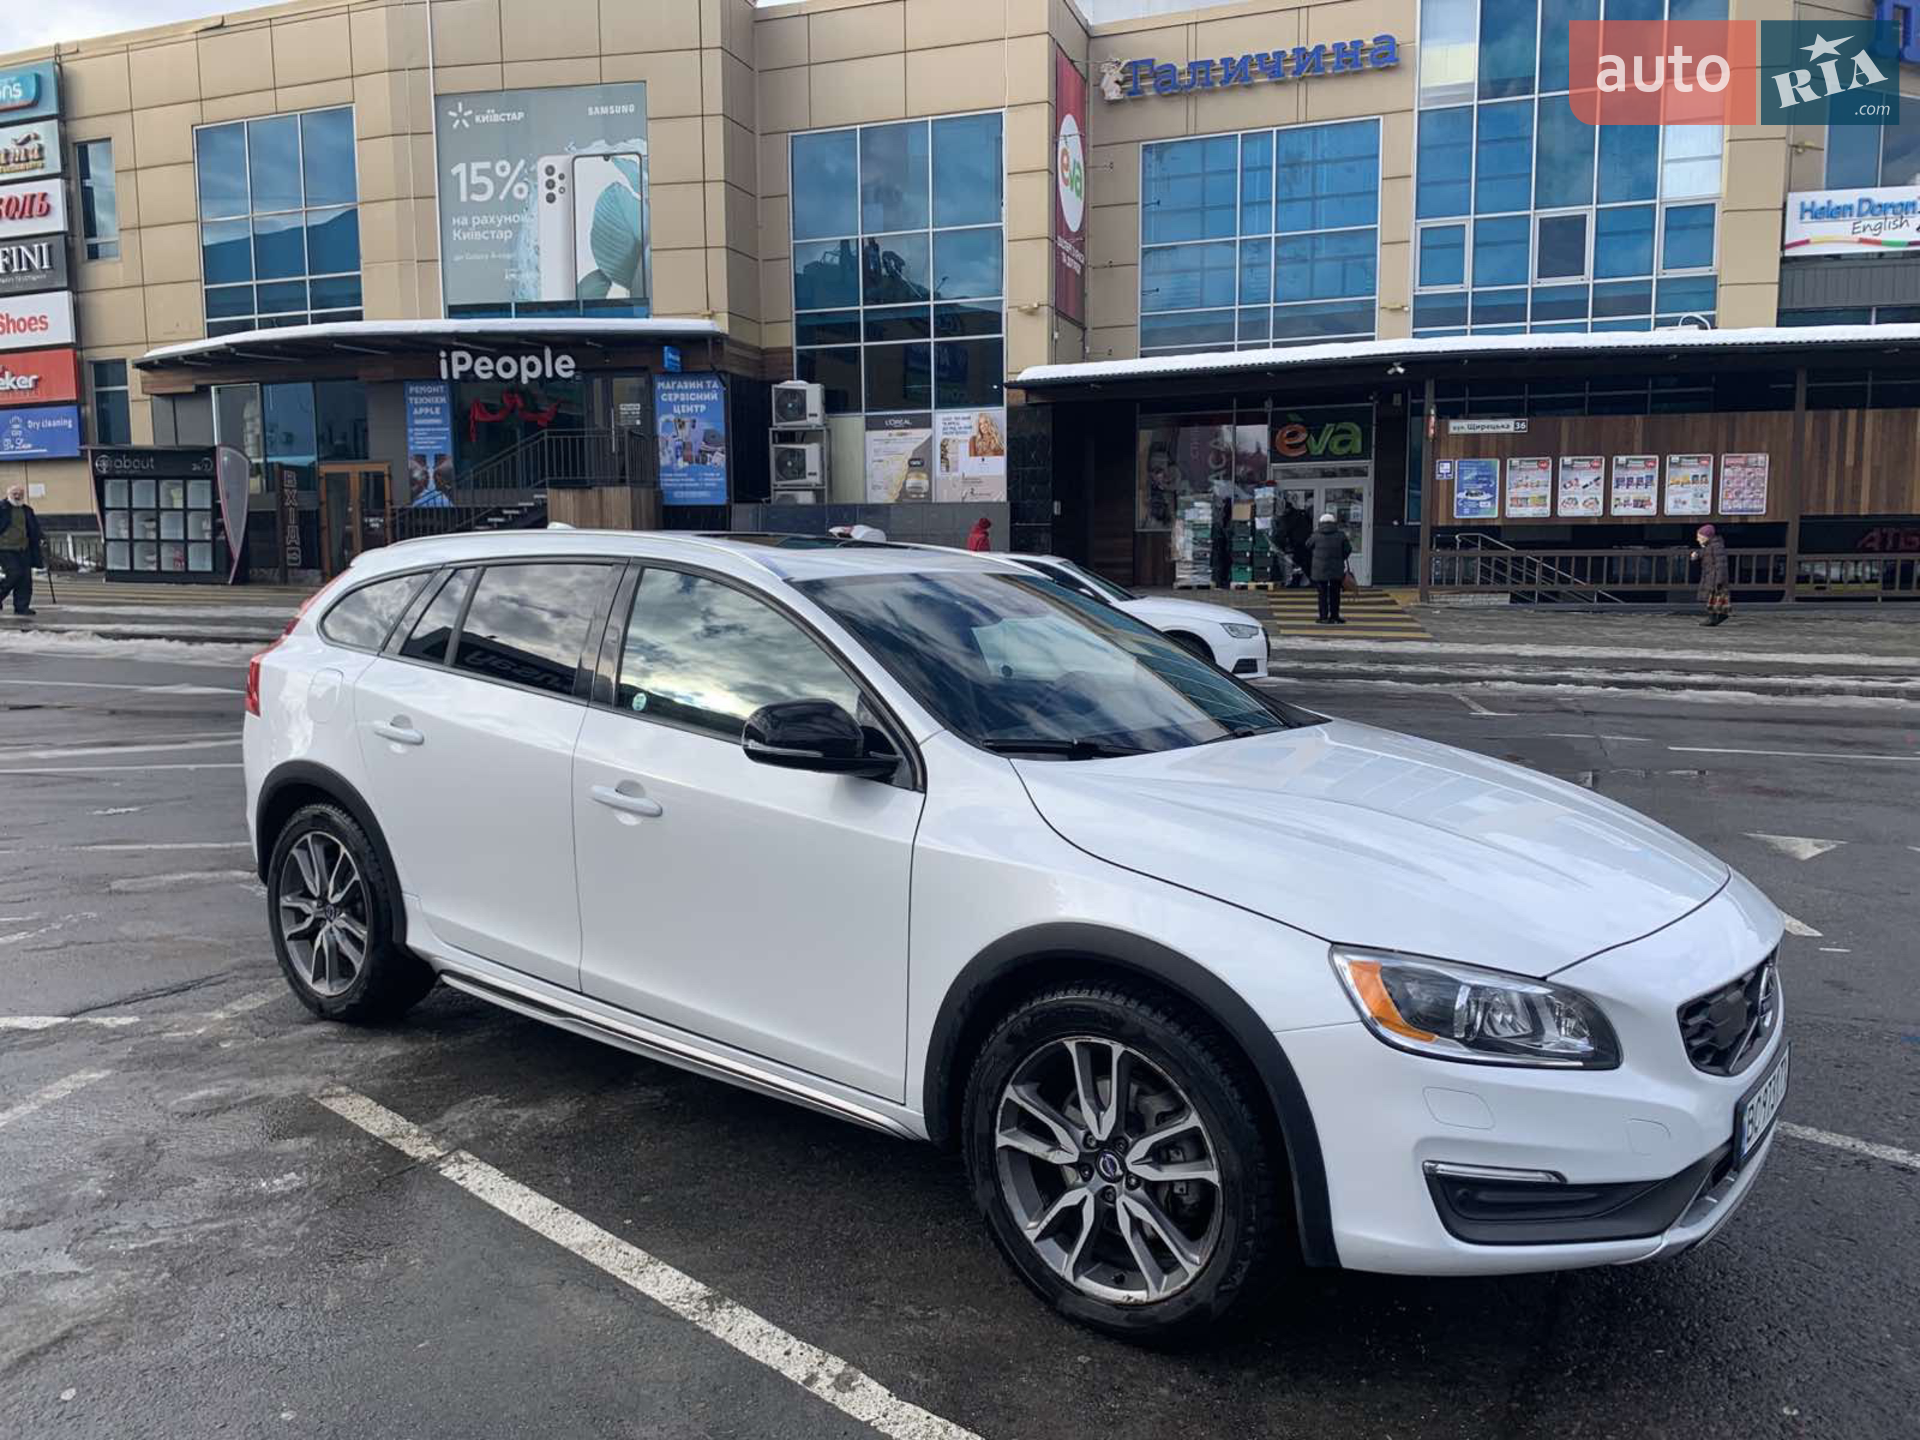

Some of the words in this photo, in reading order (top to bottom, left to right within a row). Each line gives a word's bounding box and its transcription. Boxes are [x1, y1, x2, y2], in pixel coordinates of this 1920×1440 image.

[1126, 33, 1401, 97] Галичина
[587, 104, 635, 116] SAMSUNG
[450, 159, 529, 203] 15%
[1800, 199, 1854, 220] Helen
[452, 216, 468, 227] на
[1852, 215, 1910, 236] English
[452, 228, 513, 242] Київстар
[440, 345, 576, 385] iPeople
[657, 381, 704, 391] МАГАЗИН
[706, 380, 719, 390] ТА
[660, 389, 719, 402] СЕРВІСНИЙ
[673, 404, 707, 415] ЦЕНТР
[113, 454, 155, 470] about
